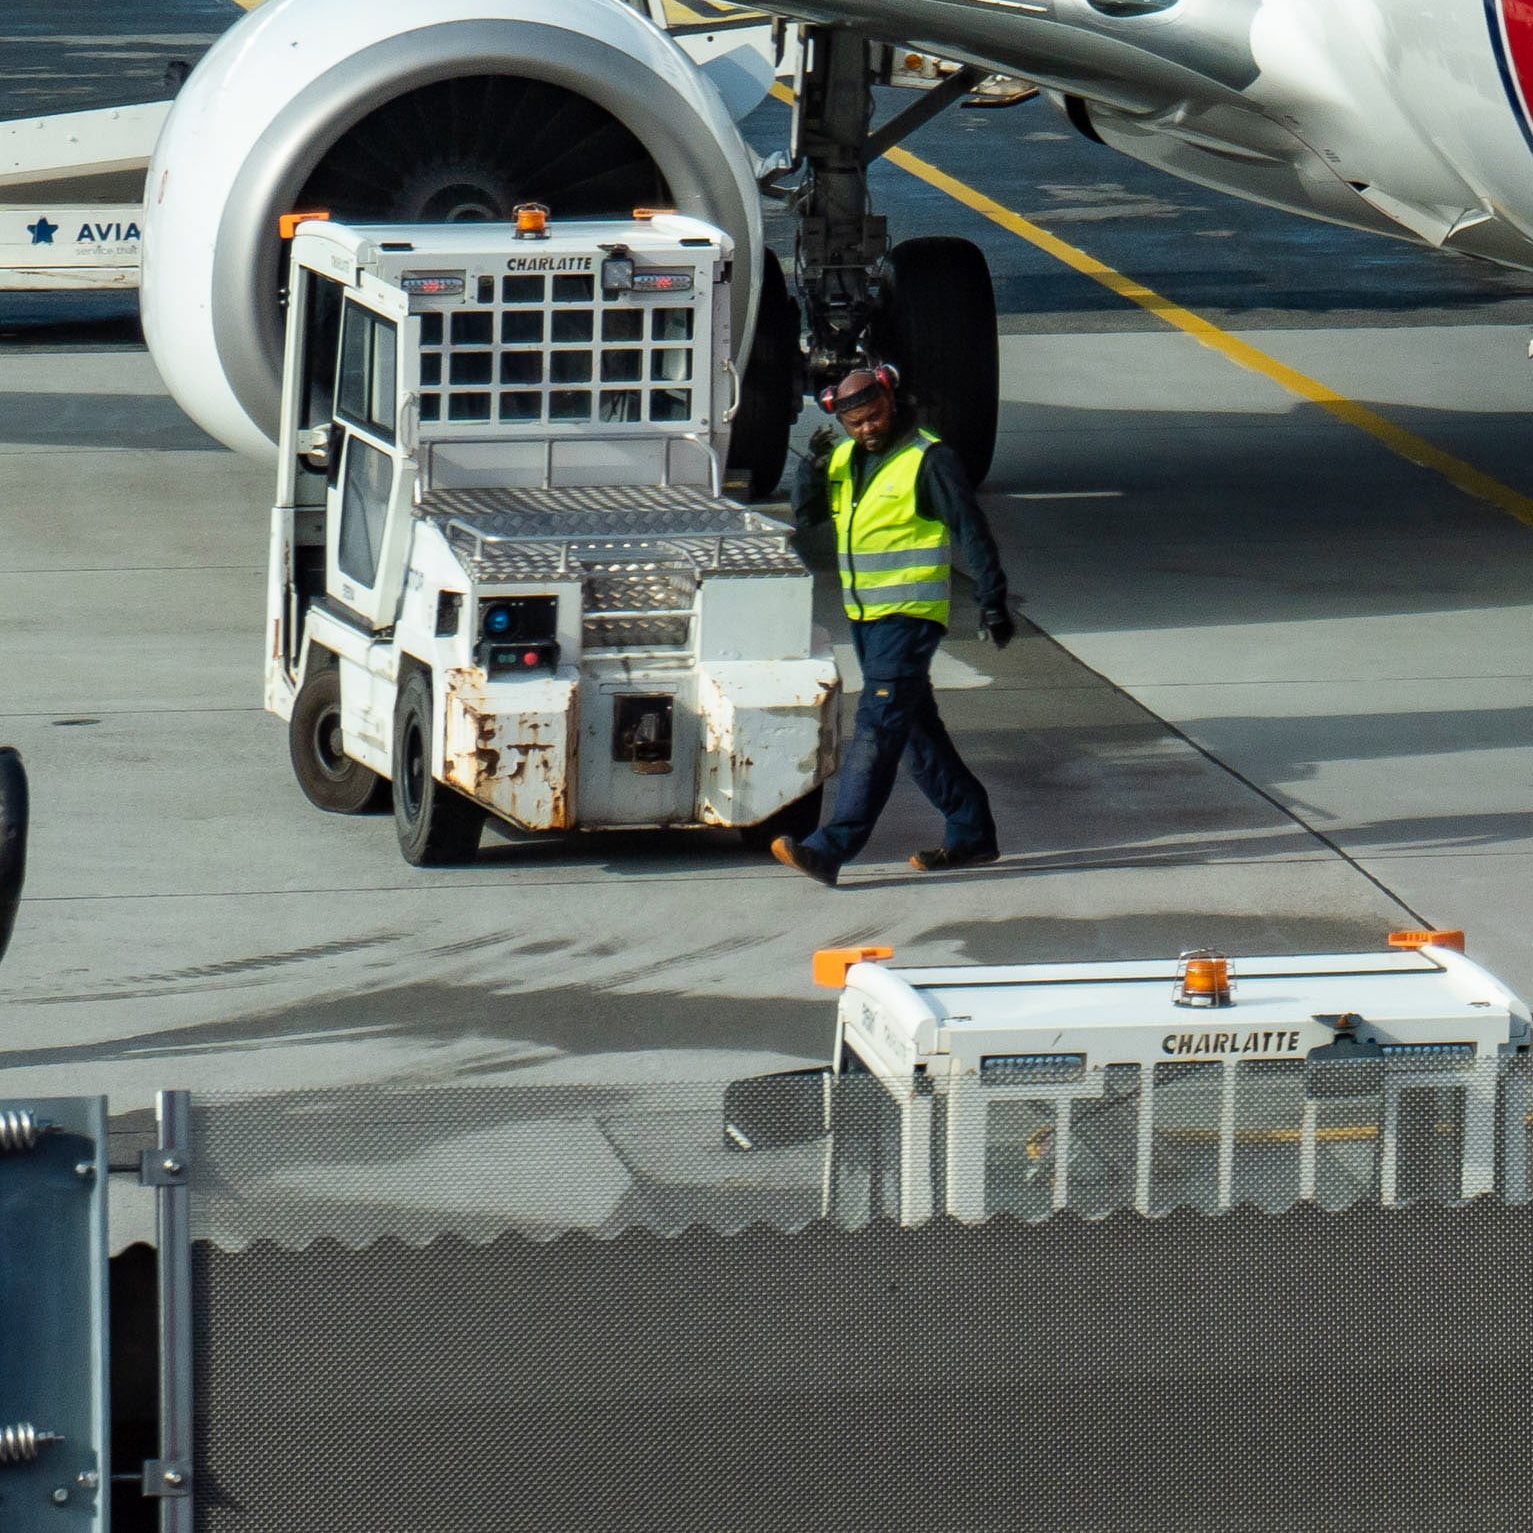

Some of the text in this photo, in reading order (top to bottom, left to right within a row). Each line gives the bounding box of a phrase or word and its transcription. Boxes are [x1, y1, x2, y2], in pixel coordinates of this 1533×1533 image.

[76, 222, 141, 242] AVIA
[507, 256, 593, 272] CHARLATTE
[1162, 1030, 1301, 1055] CHARLATTE
